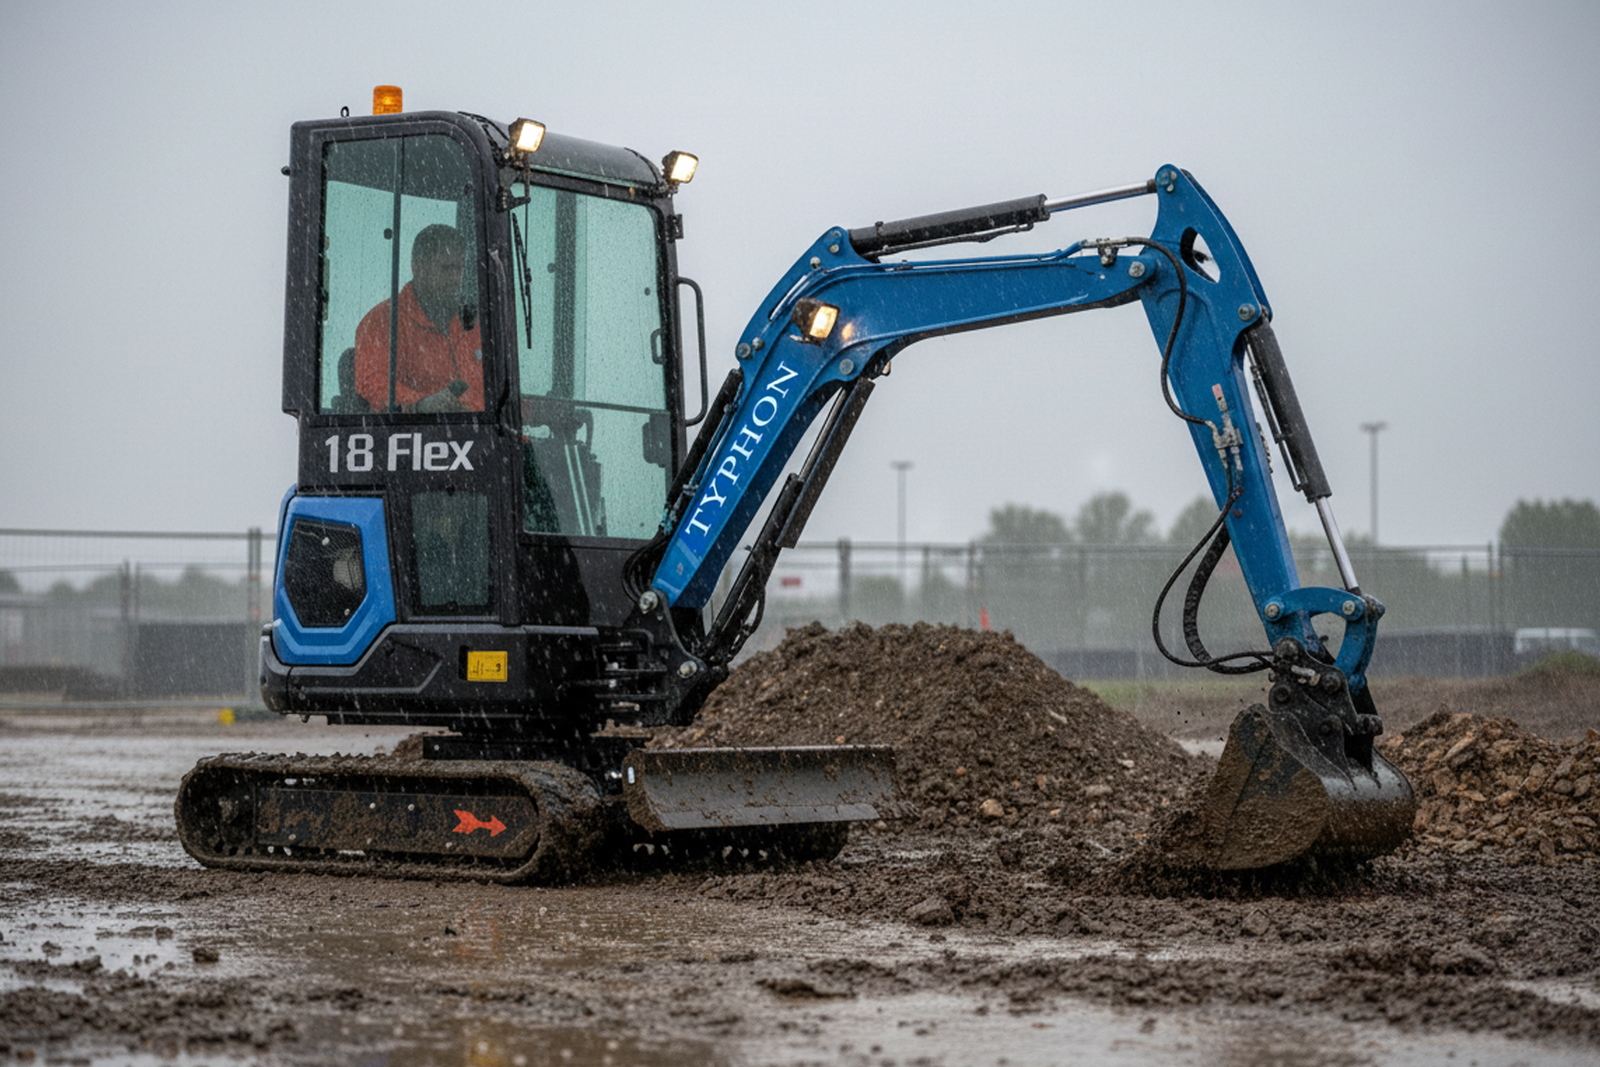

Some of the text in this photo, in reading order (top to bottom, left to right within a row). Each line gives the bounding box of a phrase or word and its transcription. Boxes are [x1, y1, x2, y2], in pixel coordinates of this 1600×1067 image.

[325, 433, 475, 473] 18 Flex
[685, 360, 799, 537] TYPHON
